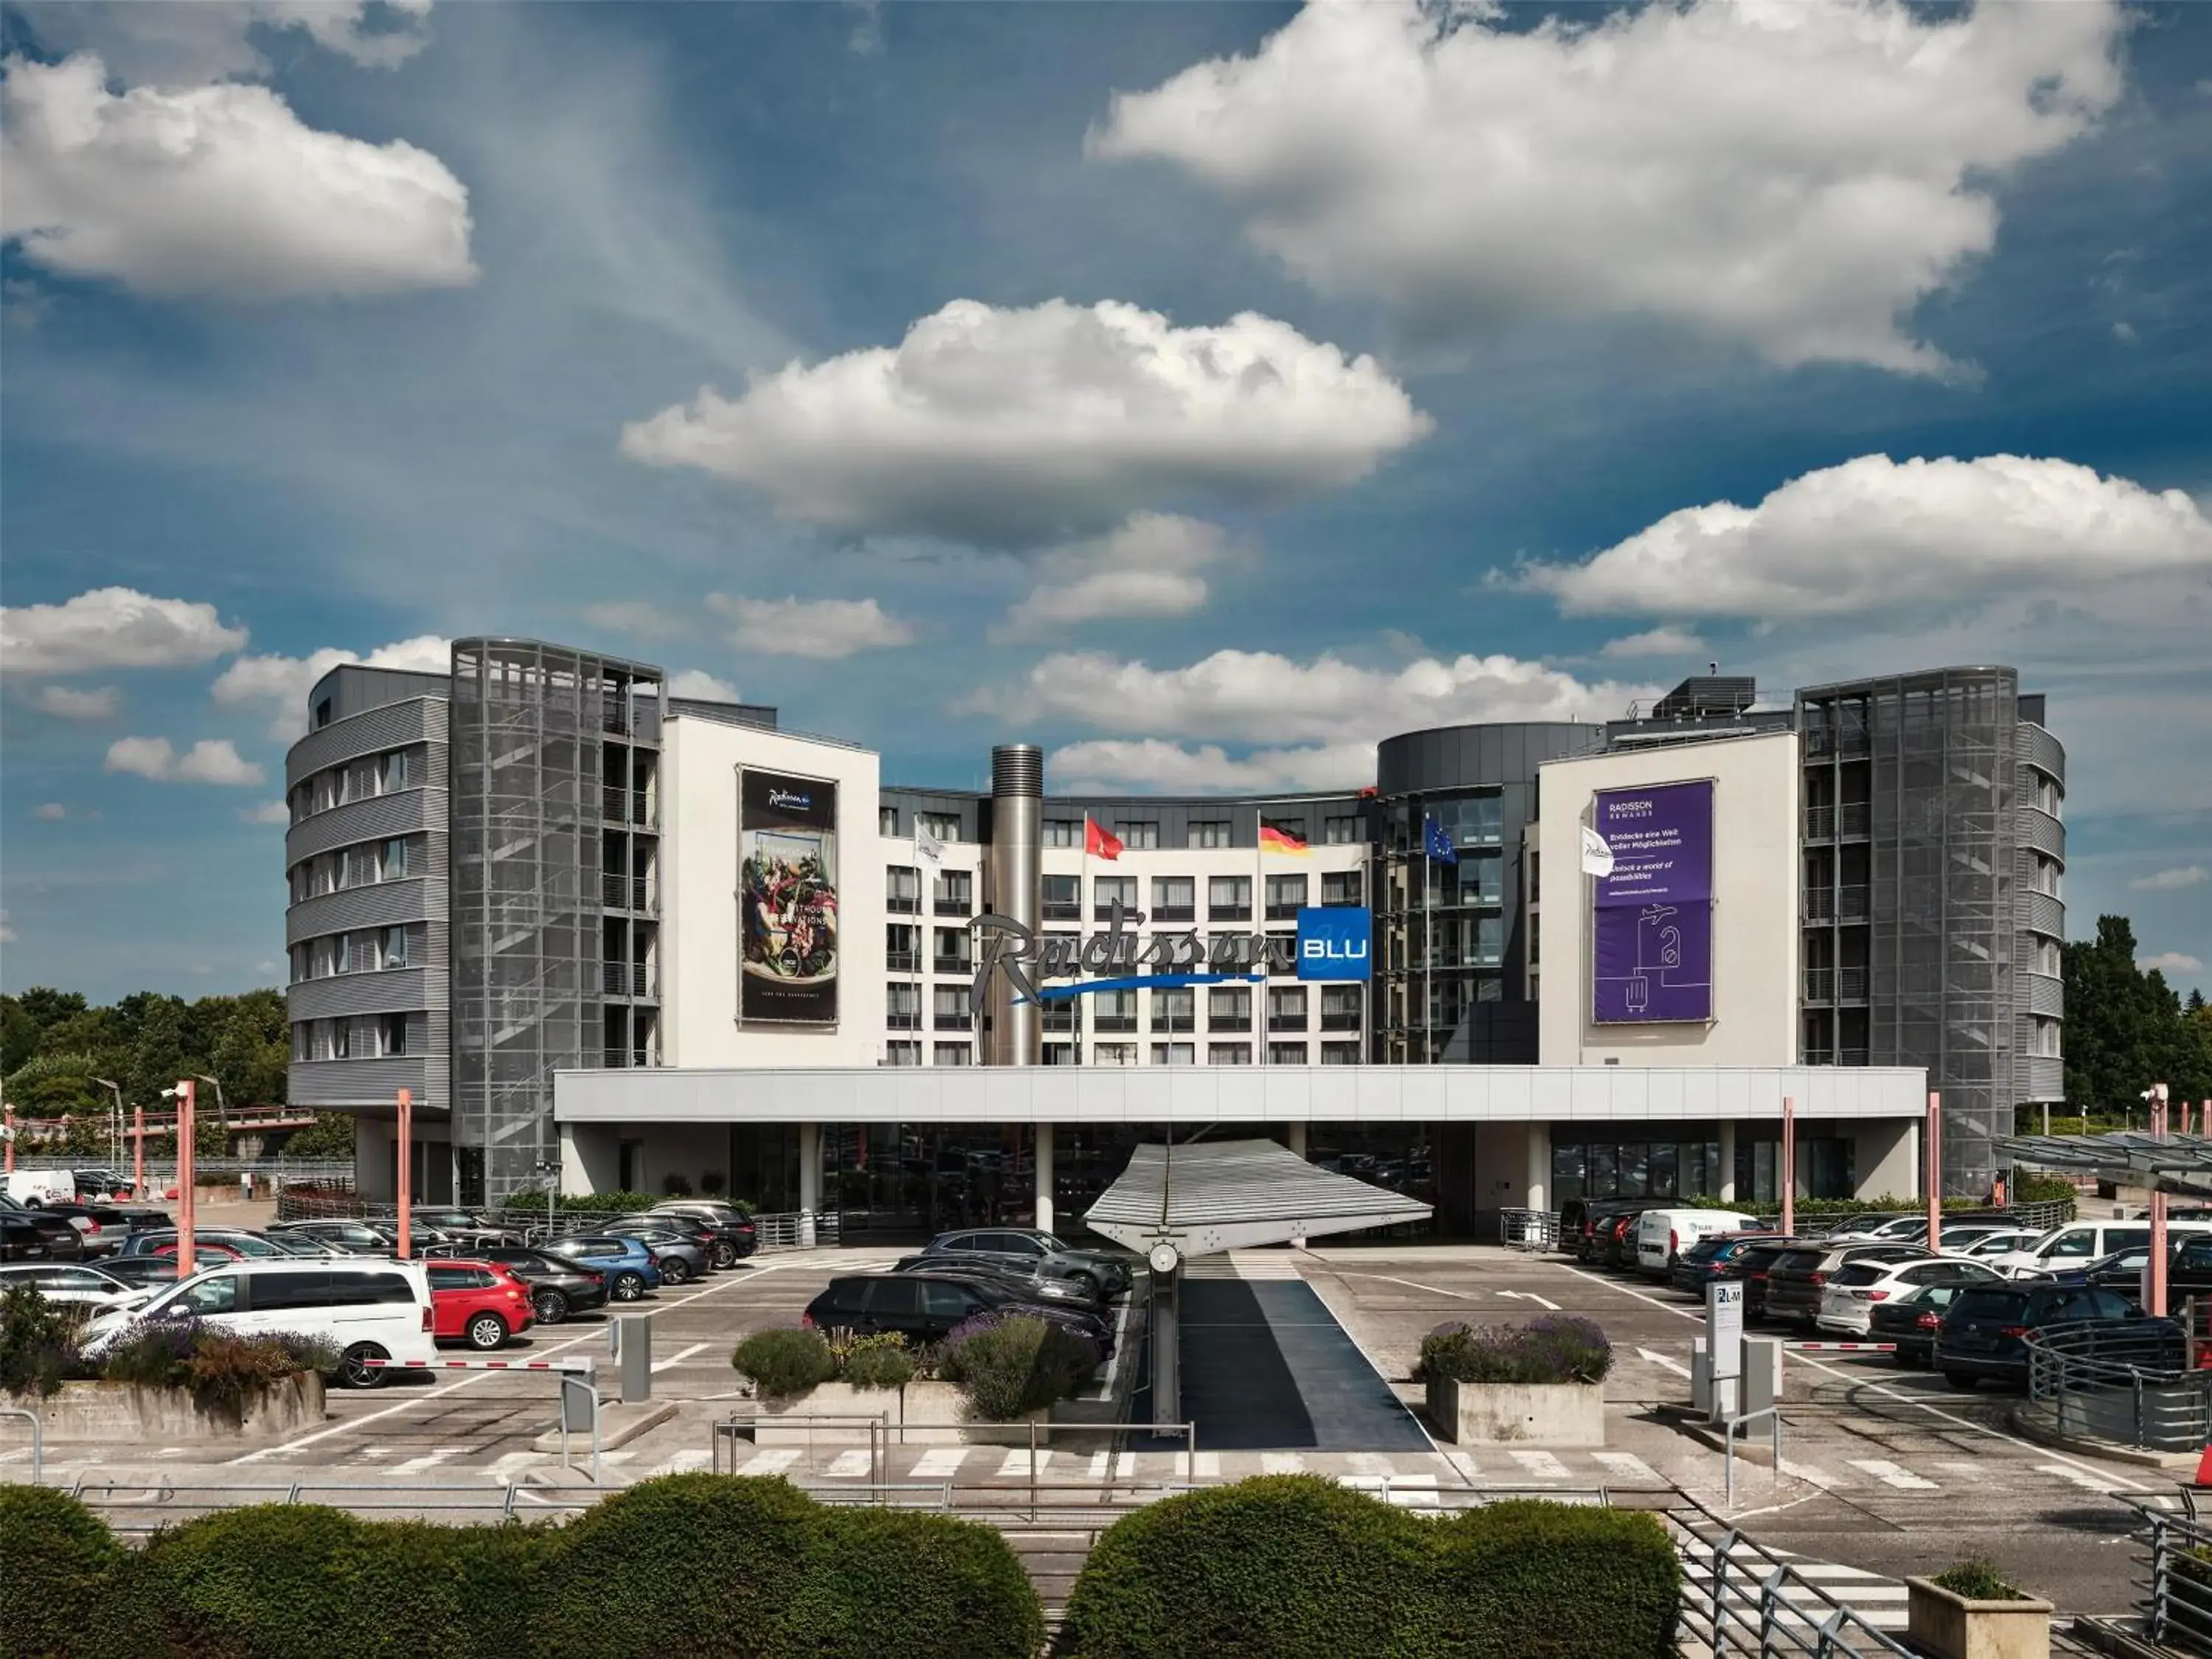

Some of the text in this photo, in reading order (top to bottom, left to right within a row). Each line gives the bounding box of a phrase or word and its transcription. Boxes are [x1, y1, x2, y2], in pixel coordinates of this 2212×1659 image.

[1610, 800, 1652, 812] RADISSON
[1610, 832, 1644, 841] Entdecke
[967, 897, 1367, 1013] Radisson BLU
